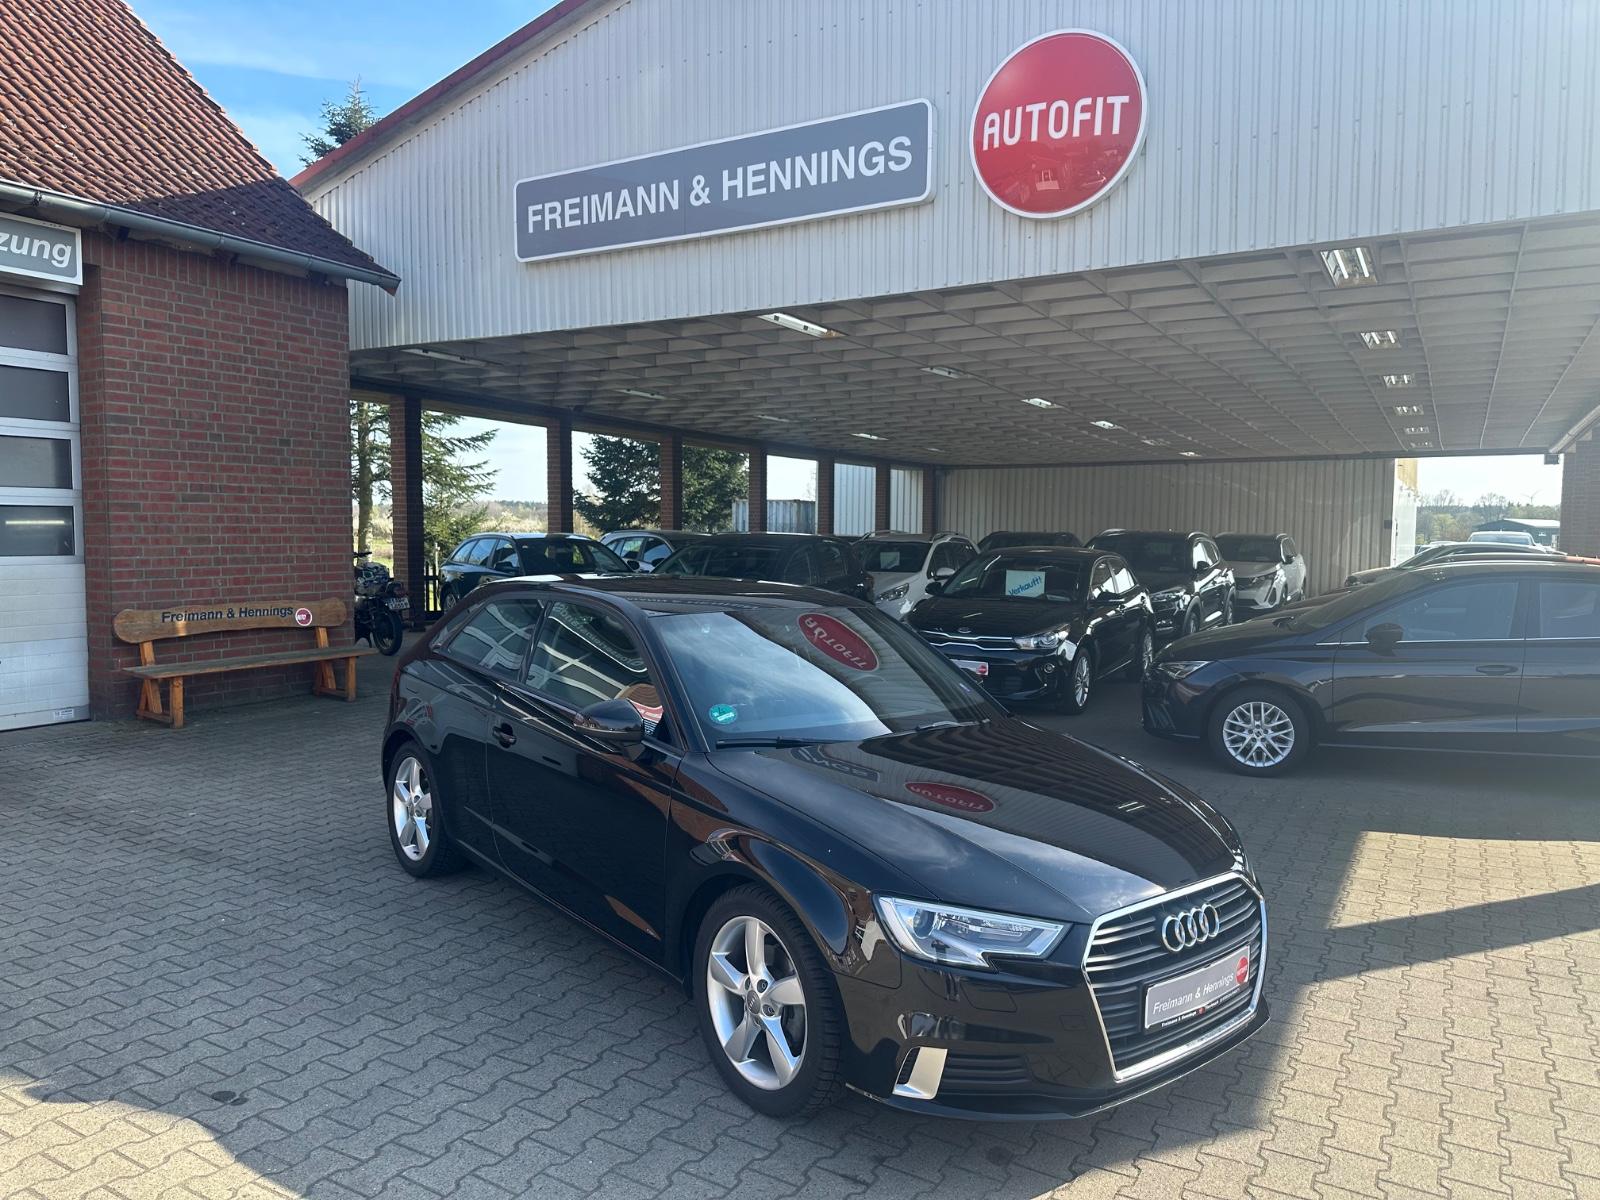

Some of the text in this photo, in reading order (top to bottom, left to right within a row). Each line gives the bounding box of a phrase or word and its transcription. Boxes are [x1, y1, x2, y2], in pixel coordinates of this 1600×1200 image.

[982, 95, 1130, 151] AUTOFIT
[527, 135, 913, 234] FREIMANN & HENNINGS
[0, 232, 72, 268] zung
[161, 609, 223, 623] Freimann
[226, 607, 235, 619] &
[239, 605, 294, 618] Hennings
[1152, 992, 1193, 1015] Freimann
[1194, 987, 1201, 999] &
[1202, 972, 1235, 996] Hennings
